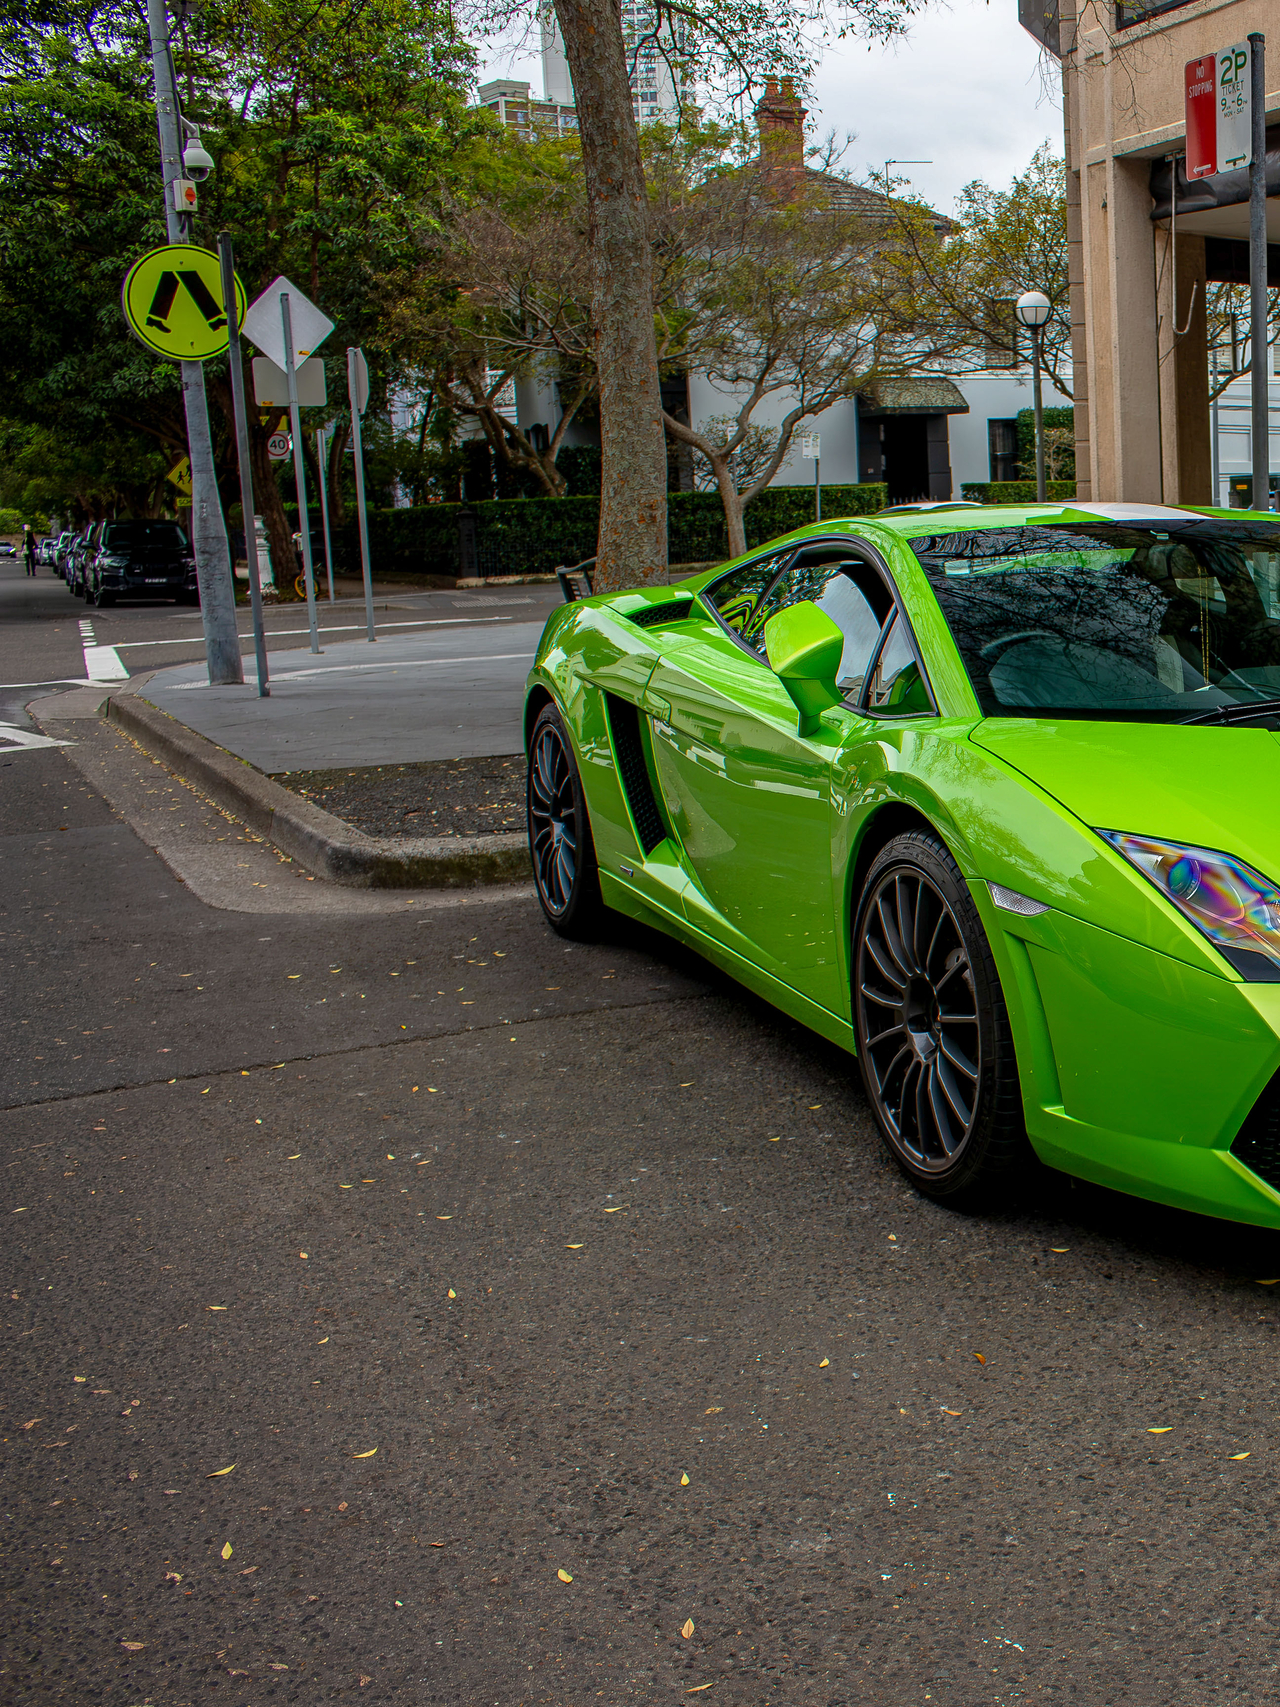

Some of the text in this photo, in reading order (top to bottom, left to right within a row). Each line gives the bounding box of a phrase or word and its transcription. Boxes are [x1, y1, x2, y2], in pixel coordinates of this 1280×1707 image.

[1195, 65, 1205, 80] NO
[1220, 50, 1247, 87] 2P
[1188, 79, 1213, 99] STOPPING
[1221, 81, 1245, 96] TICKET
[269, 439, 286, 450] 40
